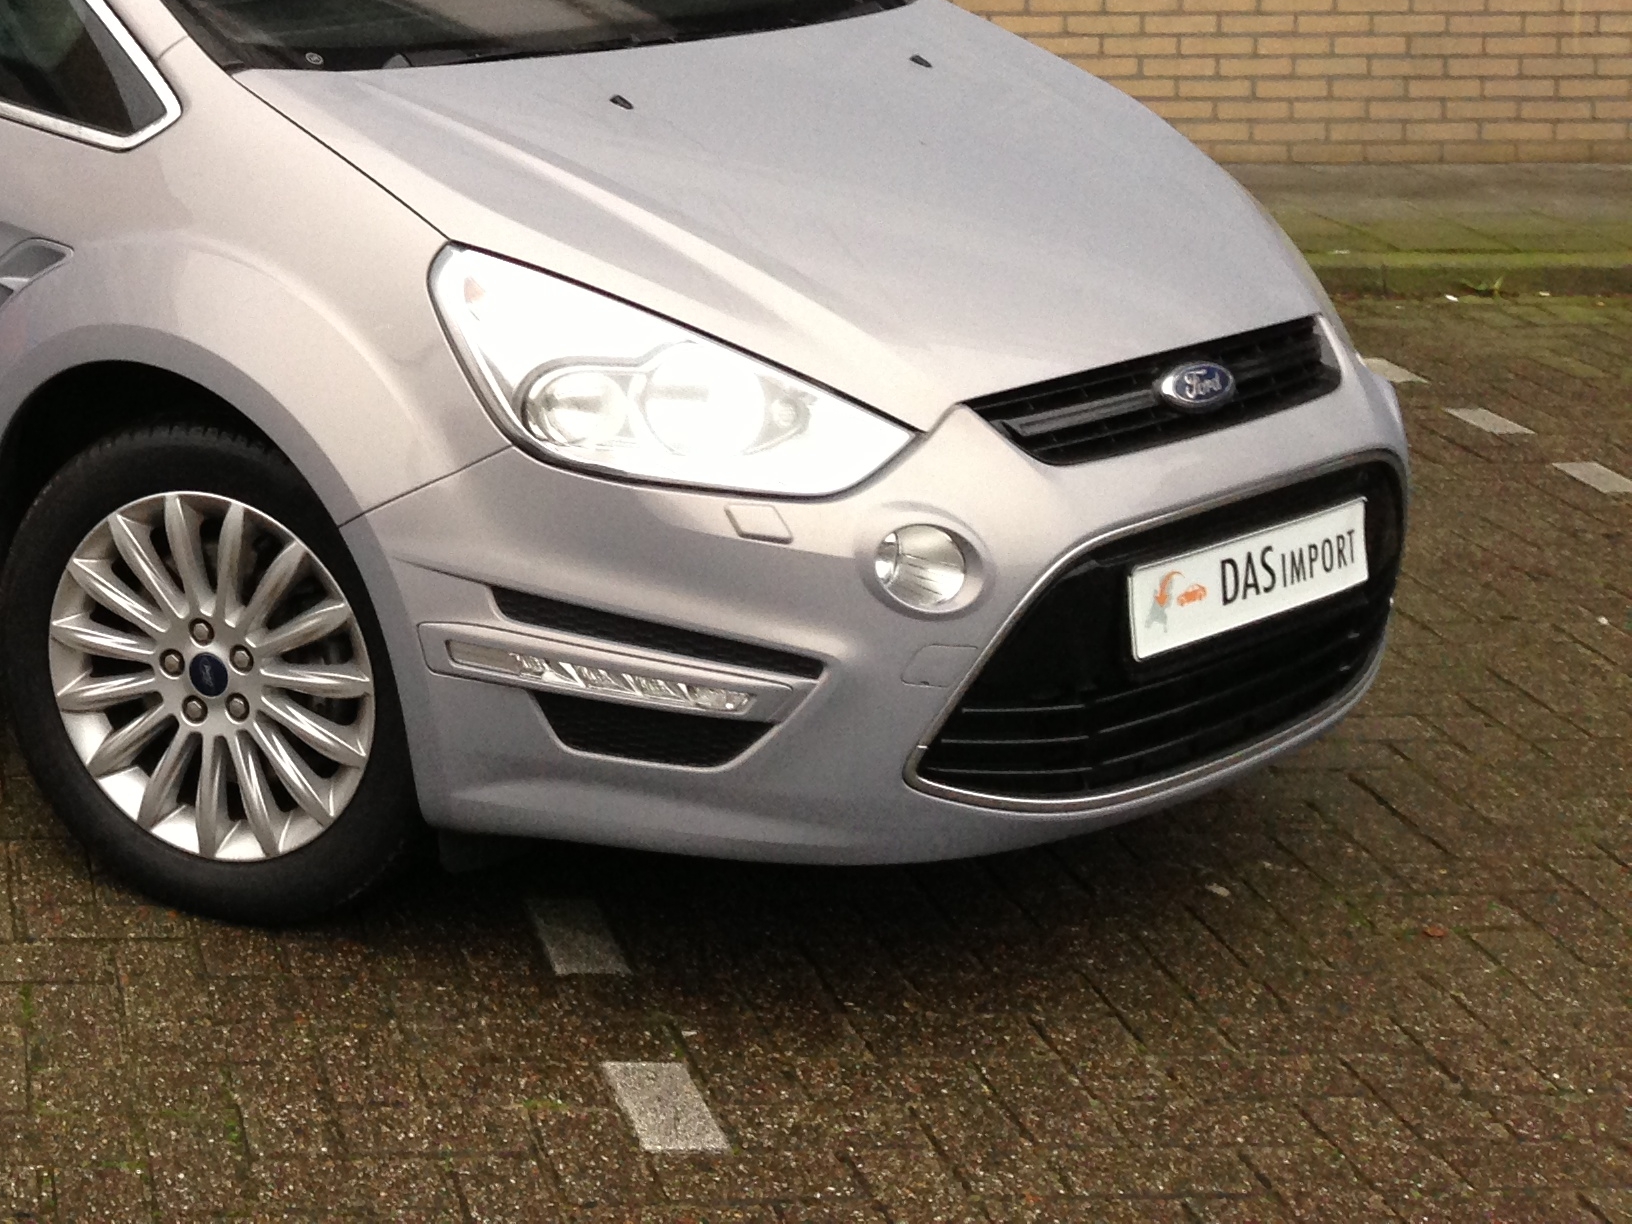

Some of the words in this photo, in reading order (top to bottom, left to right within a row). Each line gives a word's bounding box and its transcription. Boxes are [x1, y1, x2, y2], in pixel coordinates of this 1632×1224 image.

[1184, 368, 1223, 399] Ford
[1220, 545, 1276, 606] DAS
[1281, 529, 1356, 589] IMPORT
